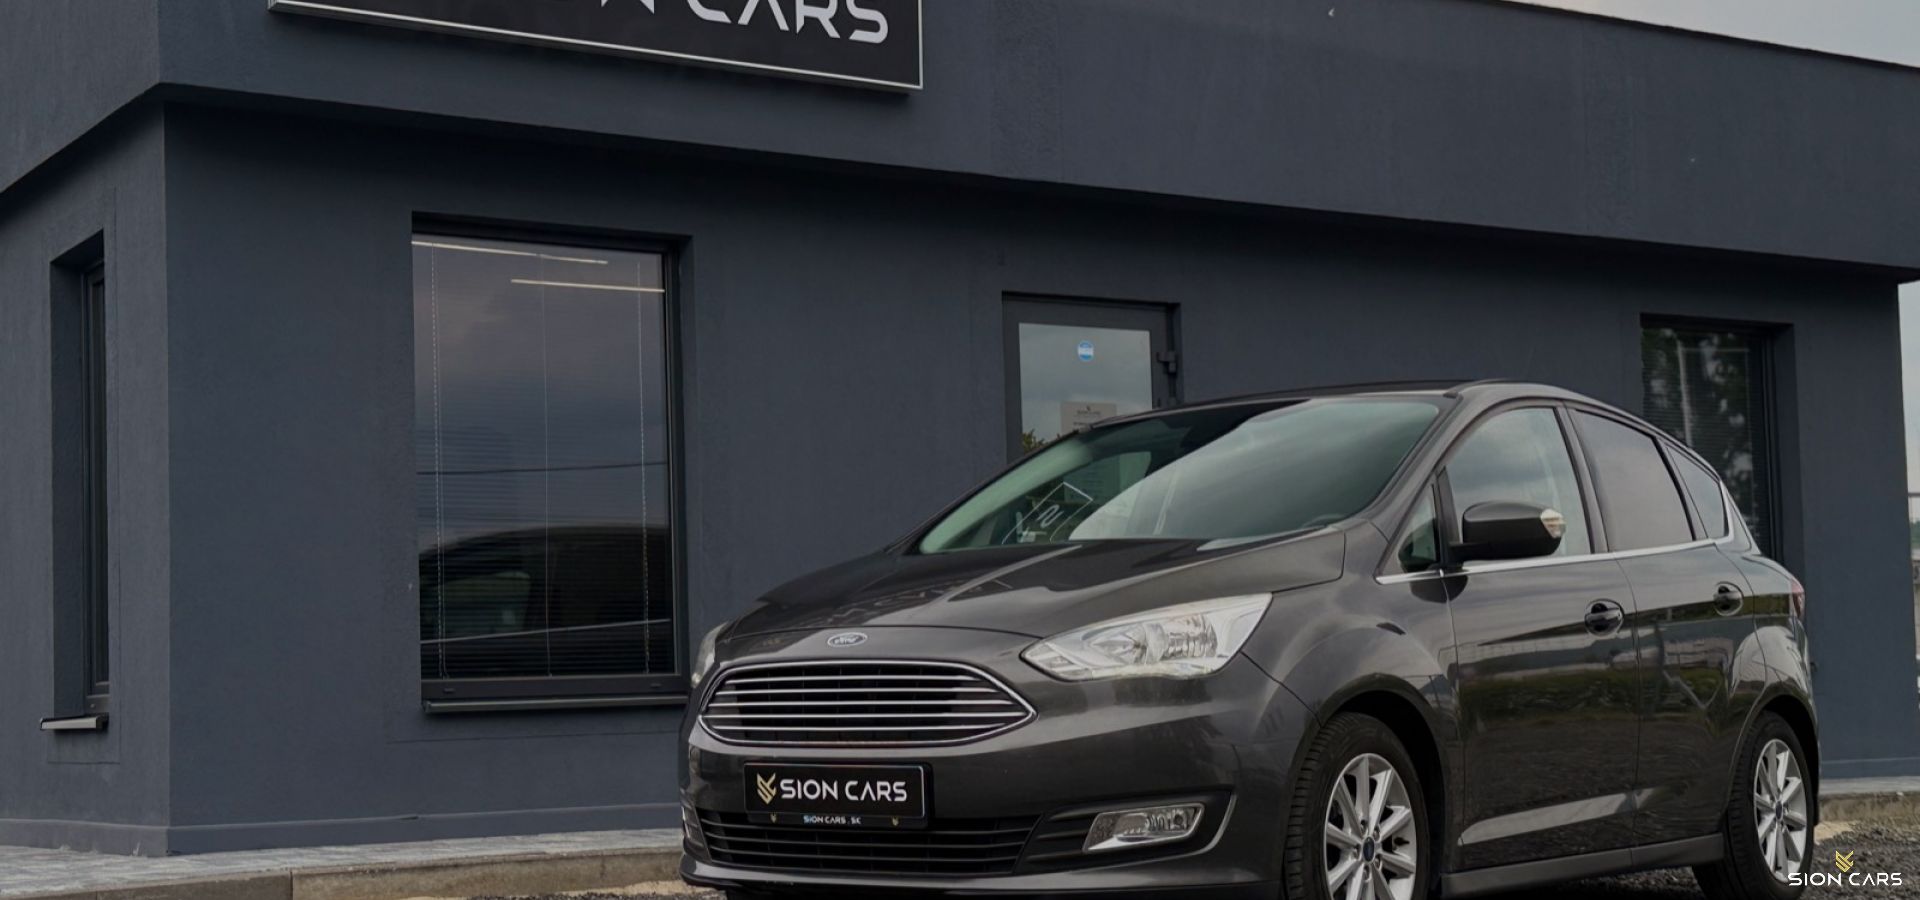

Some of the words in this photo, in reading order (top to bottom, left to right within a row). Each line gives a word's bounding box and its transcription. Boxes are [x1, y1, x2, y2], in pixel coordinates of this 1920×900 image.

[780, 779, 838, 800] SION
[845, 780, 907, 802] CARS
[803, 815, 823, 824] SION
[825, 816, 846, 825] CARS
